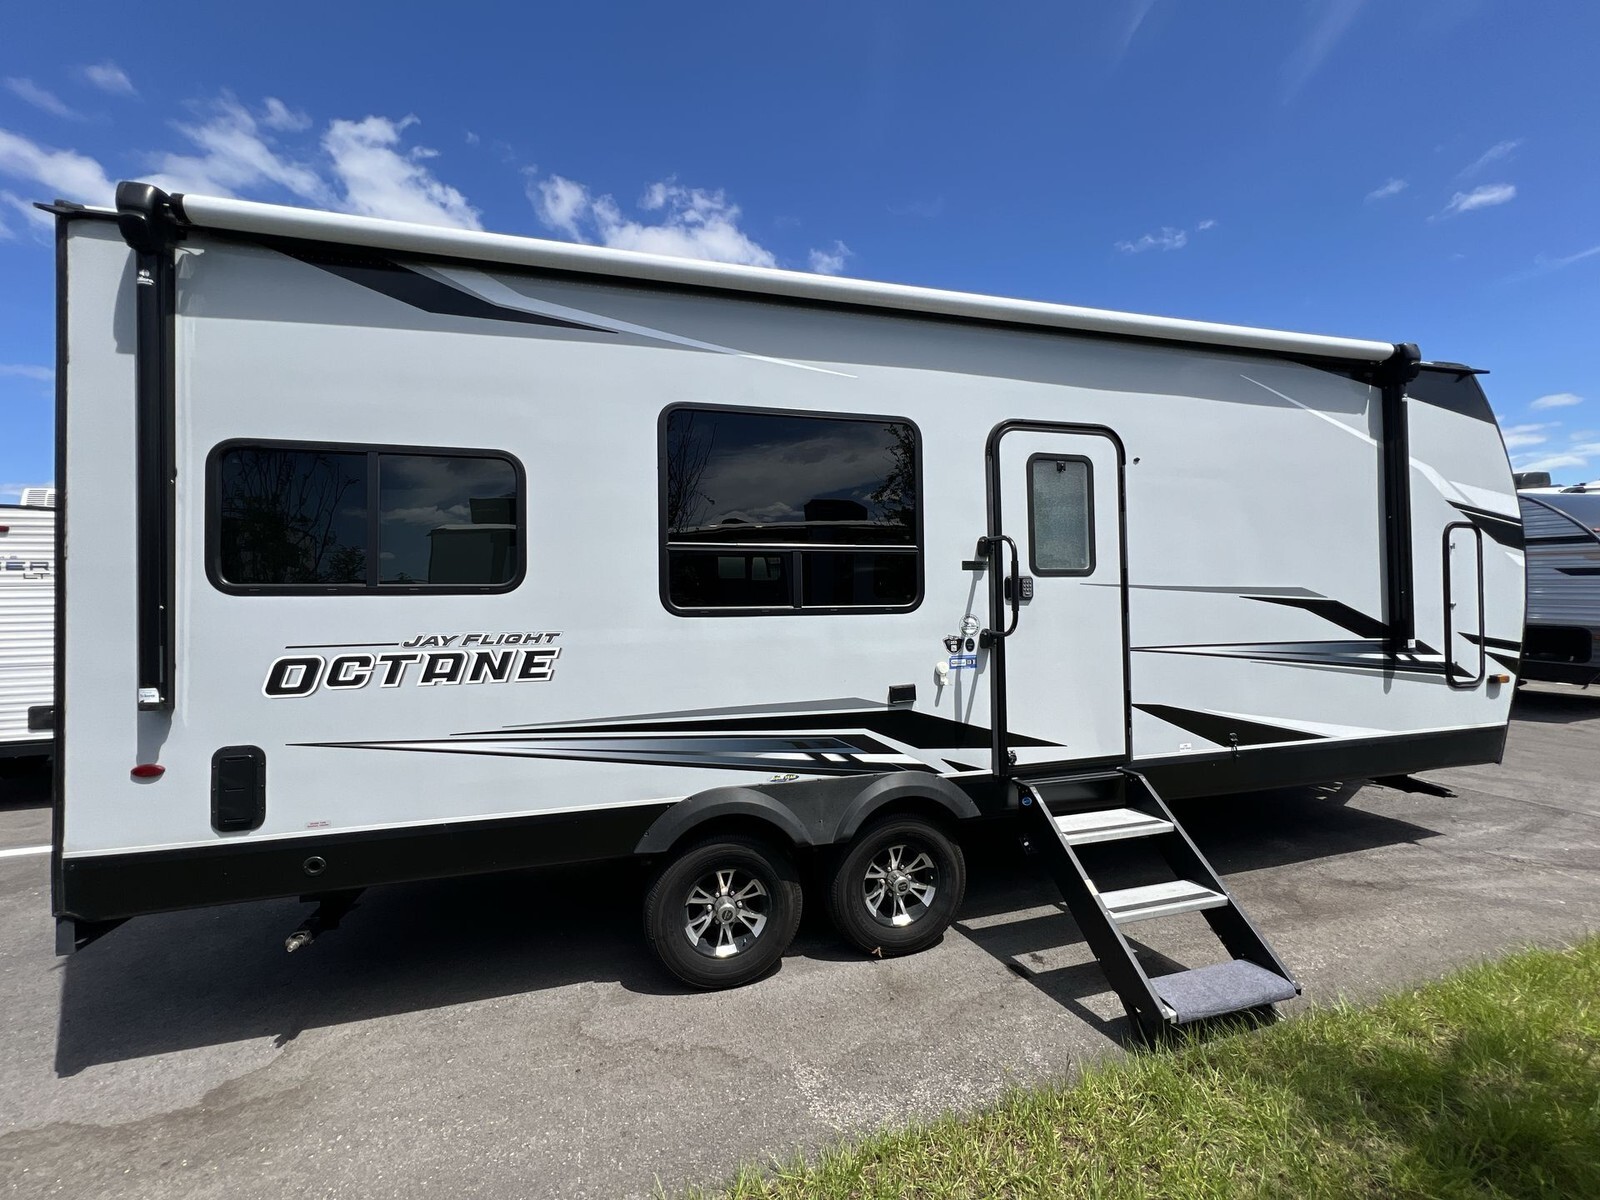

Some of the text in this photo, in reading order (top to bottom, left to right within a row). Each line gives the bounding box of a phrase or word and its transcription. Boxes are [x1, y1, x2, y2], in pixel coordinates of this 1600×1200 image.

[0, 561, 50, 571] ER
[23, 572, 50, 580] LT
[402, 632, 561, 648] JAY FLIGHT
[263, 648, 560, 698] OCTANE
